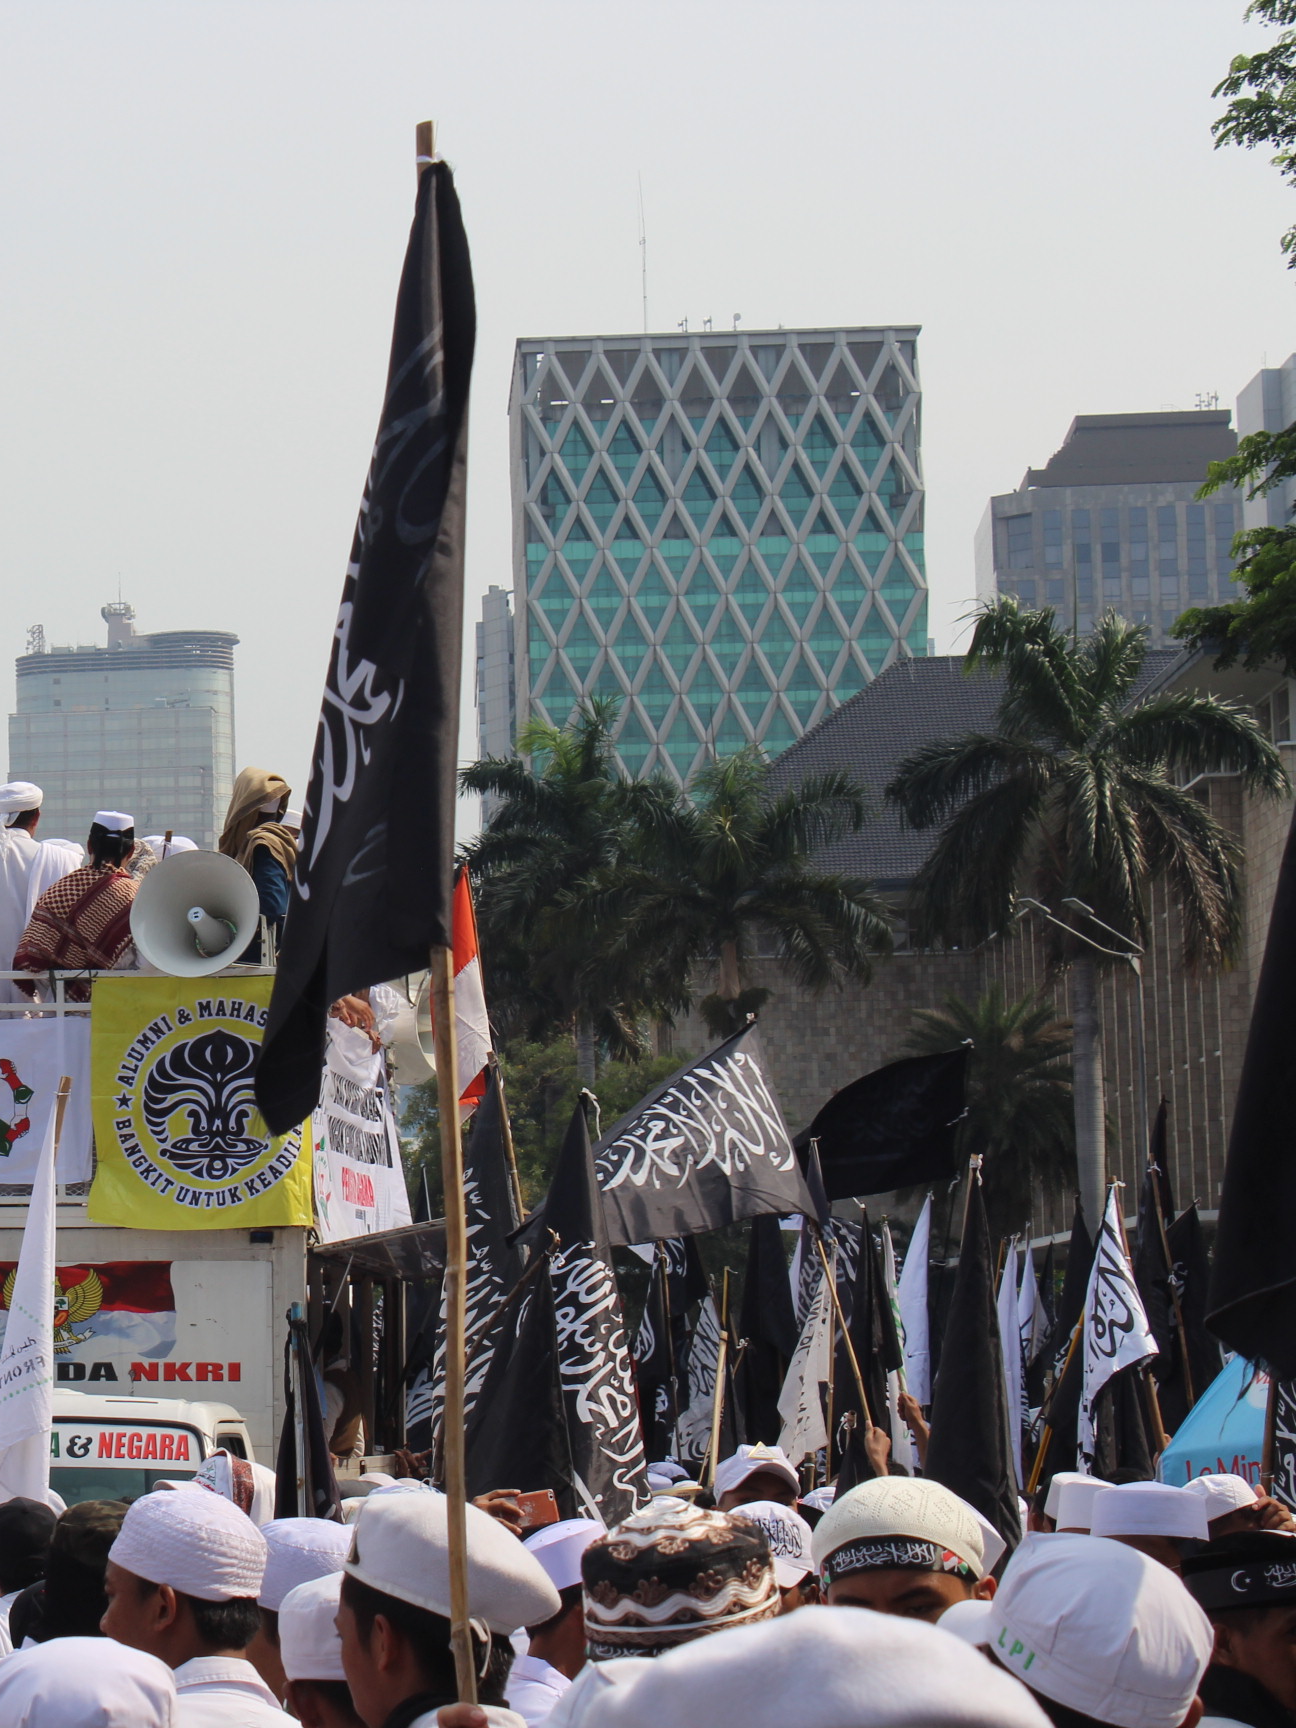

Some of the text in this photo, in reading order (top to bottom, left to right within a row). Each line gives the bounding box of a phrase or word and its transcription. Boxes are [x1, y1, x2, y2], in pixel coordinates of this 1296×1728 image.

[117, 999, 270, 1088] ALUMNI & MAHAS
[115, 1117, 175, 1195] BANGKIT
[175, 1186, 243, 1208] UNTUK
[245, 1127, 303, 1197] KEADIL
[130, 1361, 242, 1382] NKRI
[66, 1434, 93, 1458] &
[97, 1431, 190, 1462] NEGARA
[997, 1625, 1036, 1671] LPI
